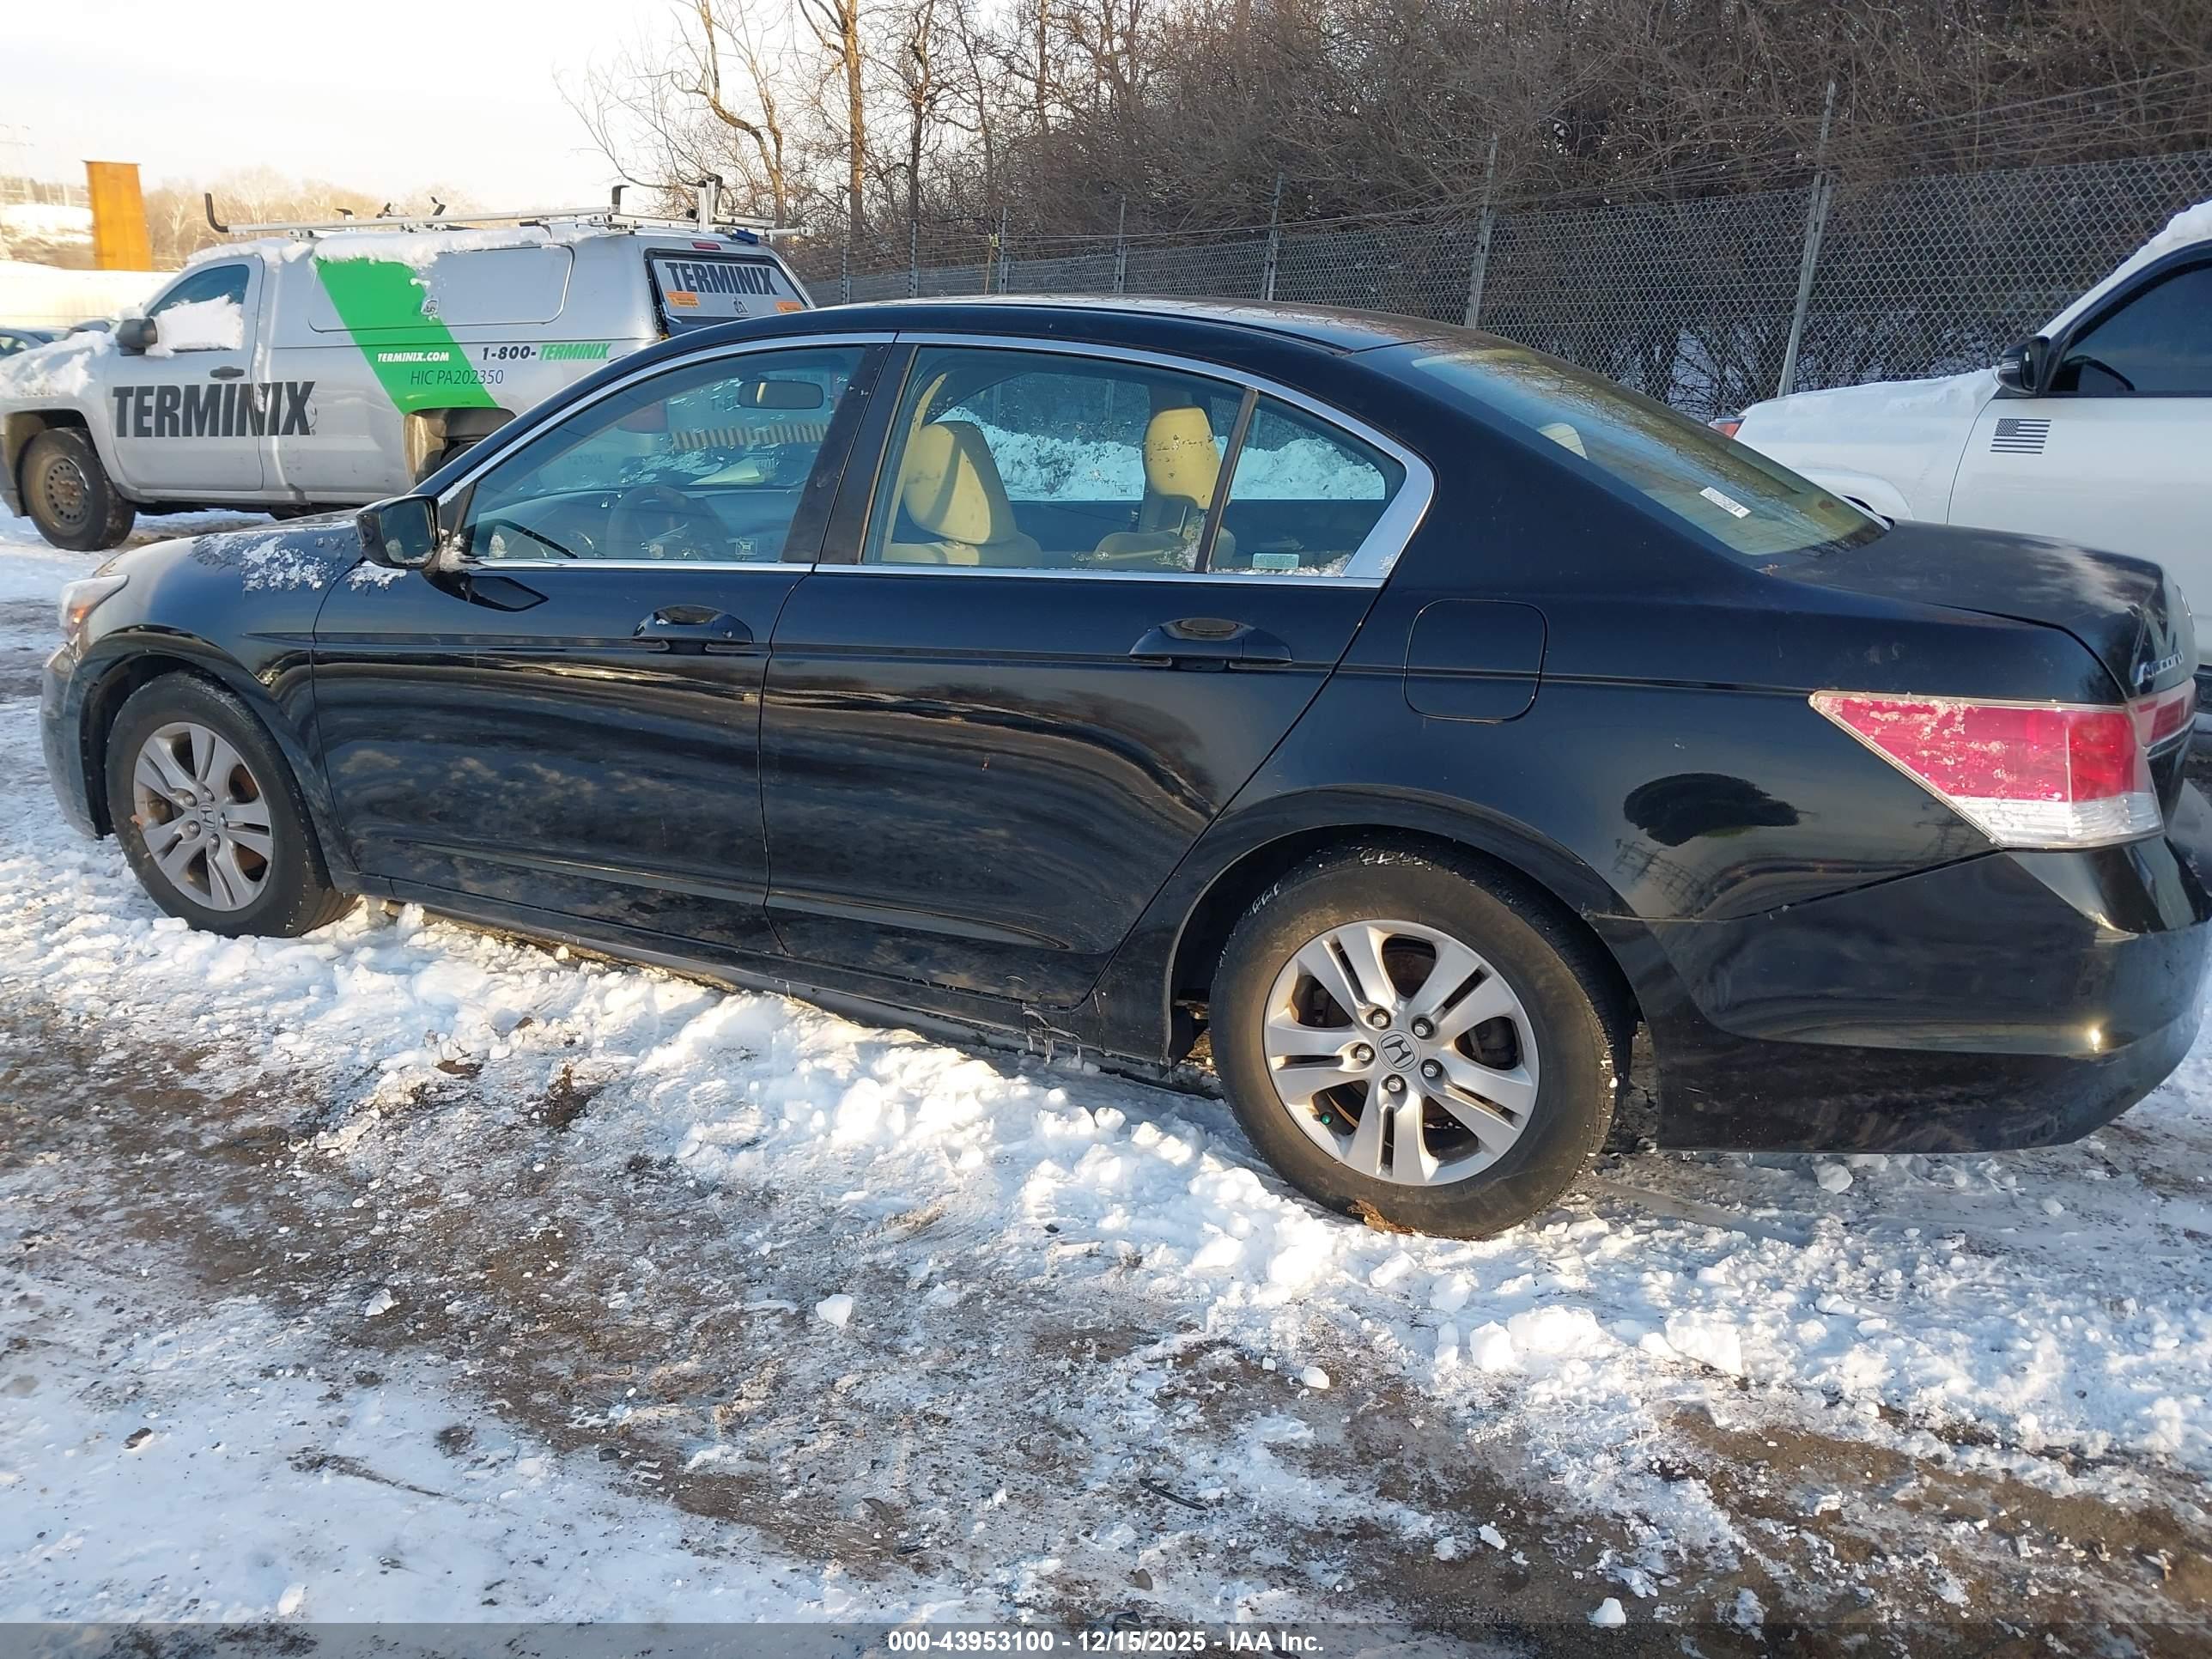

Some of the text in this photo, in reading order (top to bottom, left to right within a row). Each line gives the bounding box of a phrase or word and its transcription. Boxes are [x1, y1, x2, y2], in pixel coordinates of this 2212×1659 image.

[665, 262, 778, 295] TERMINIX
[377, 352, 450, 363] TERMINIX.COM
[410, 369, 504, 385] HIC PA202350
[112, 381, 315, 437] TERMINIX
